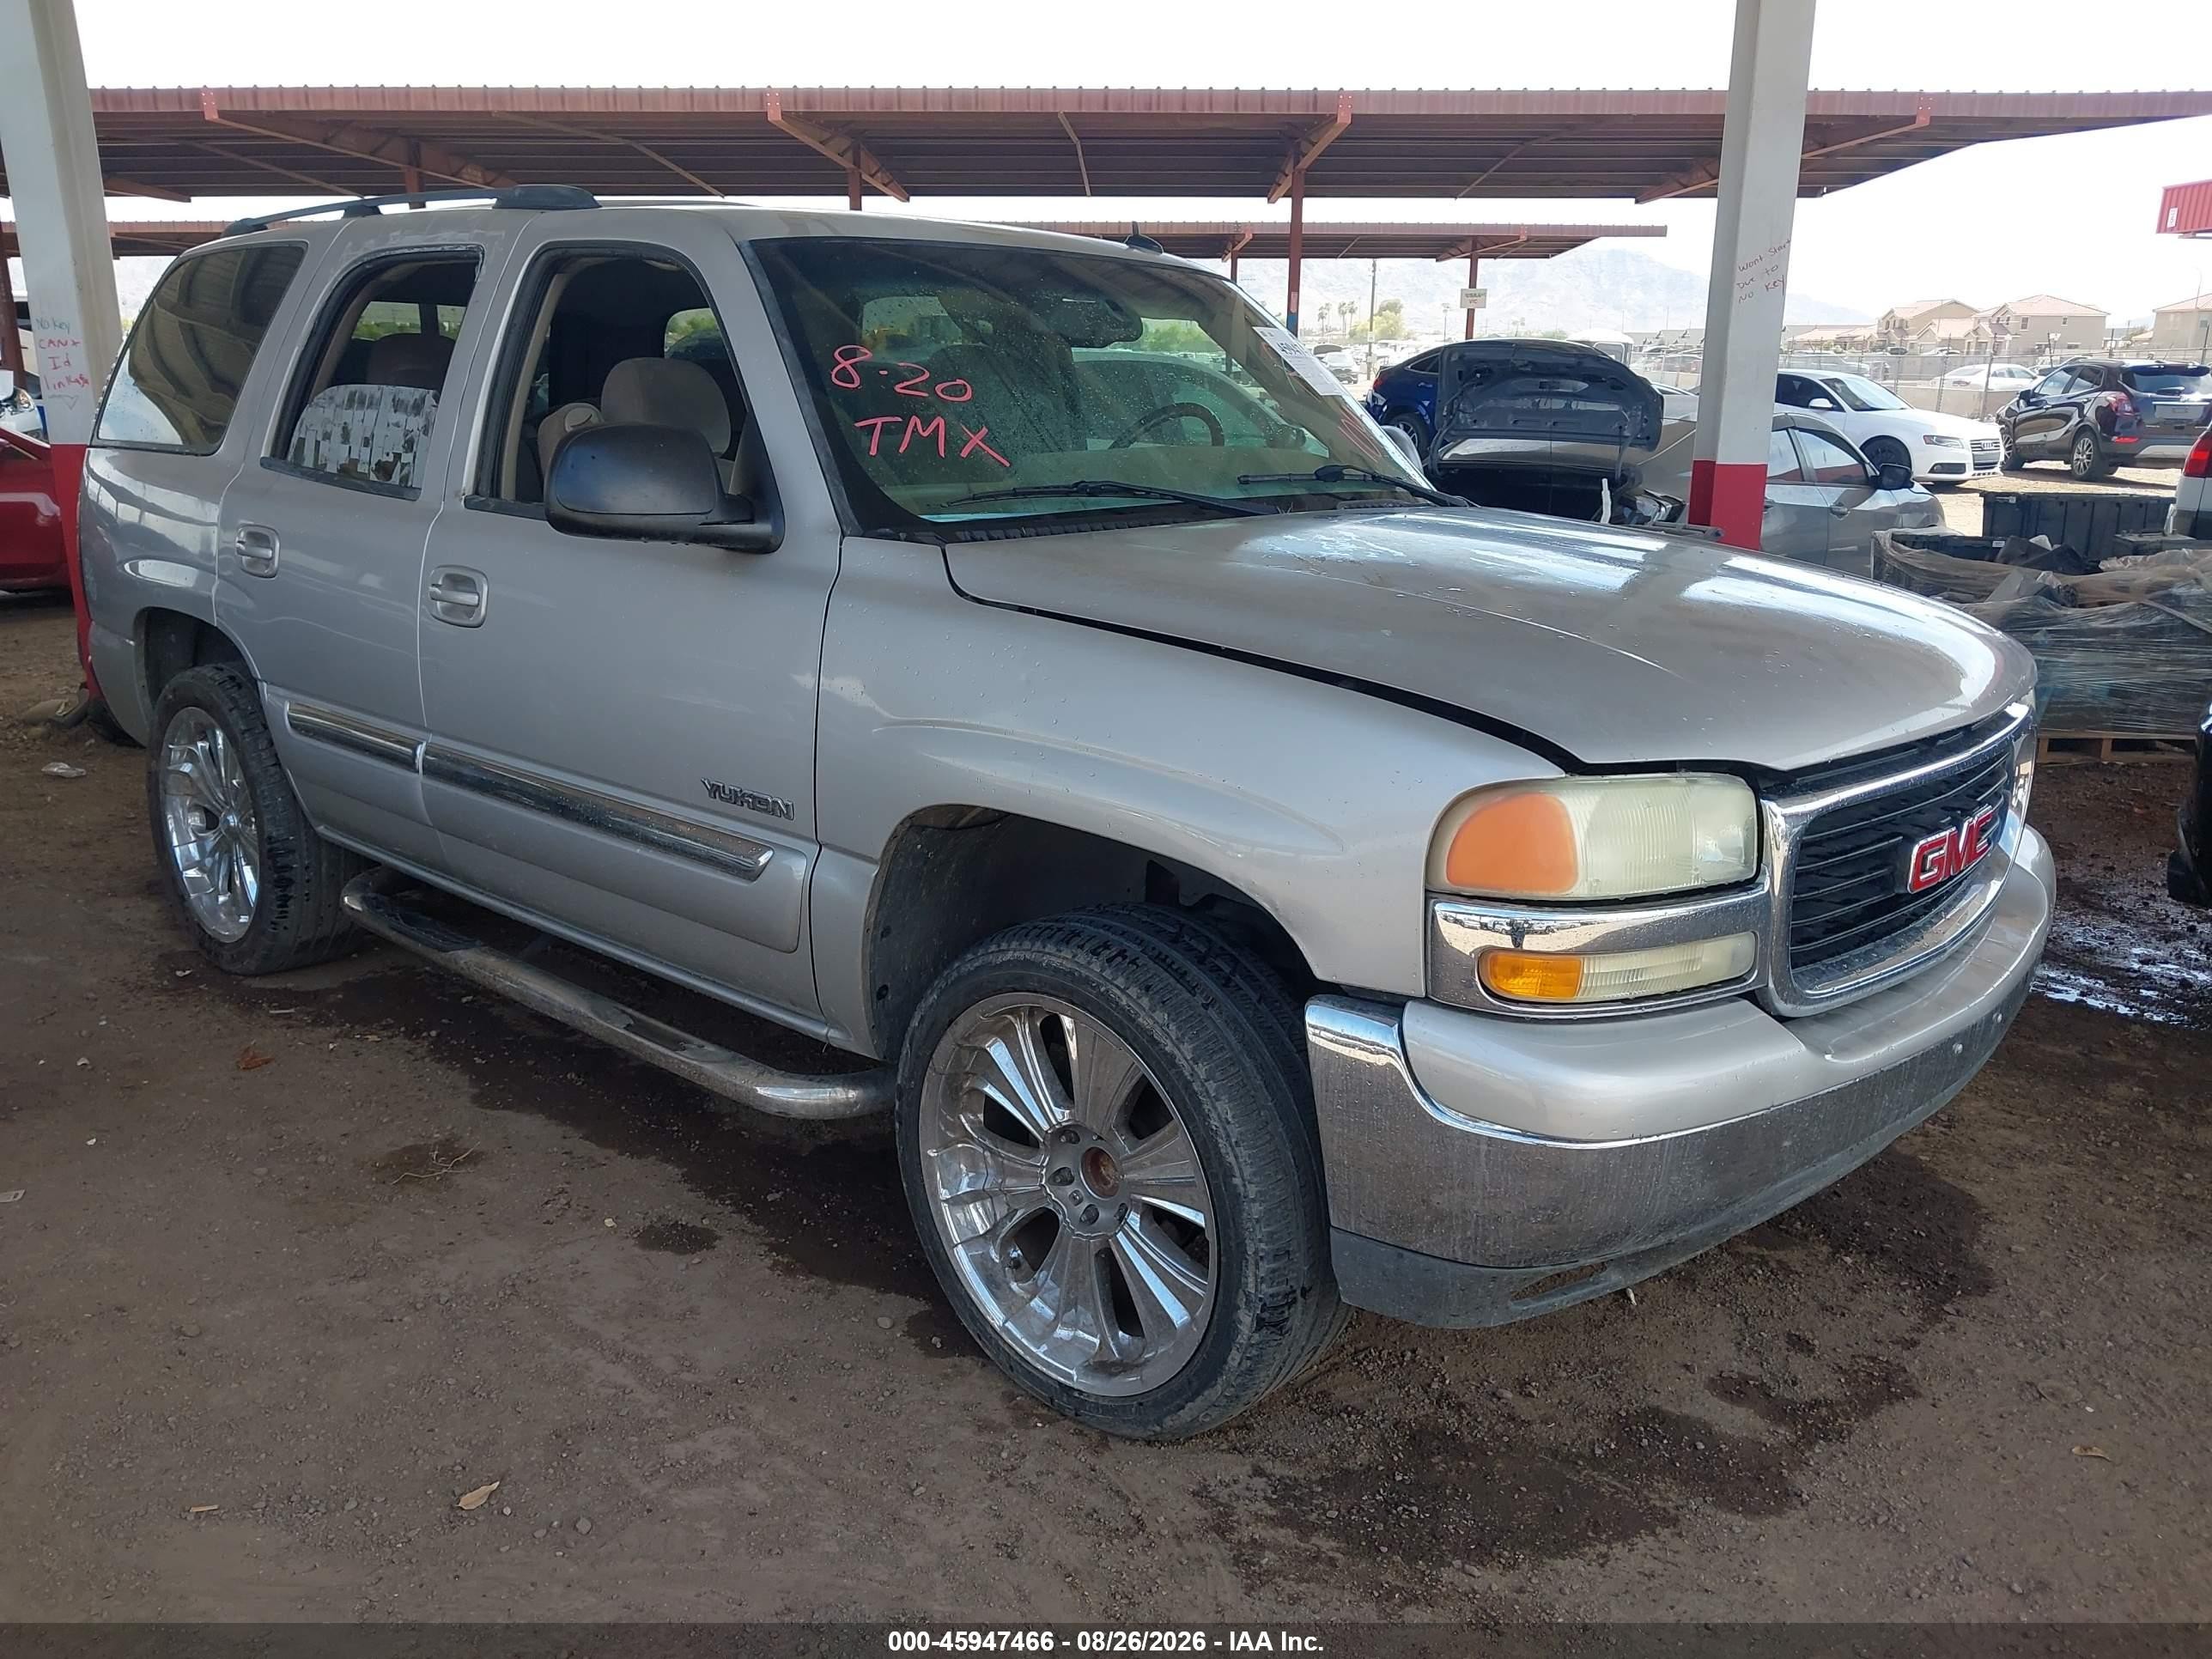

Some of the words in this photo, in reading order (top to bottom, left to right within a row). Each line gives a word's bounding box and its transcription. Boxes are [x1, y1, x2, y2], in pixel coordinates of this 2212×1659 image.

[854, 415, 1012, 468] TMX
[700, 776, 795, 821] YUKON
[1907, 804, 1994, 894] GMC
